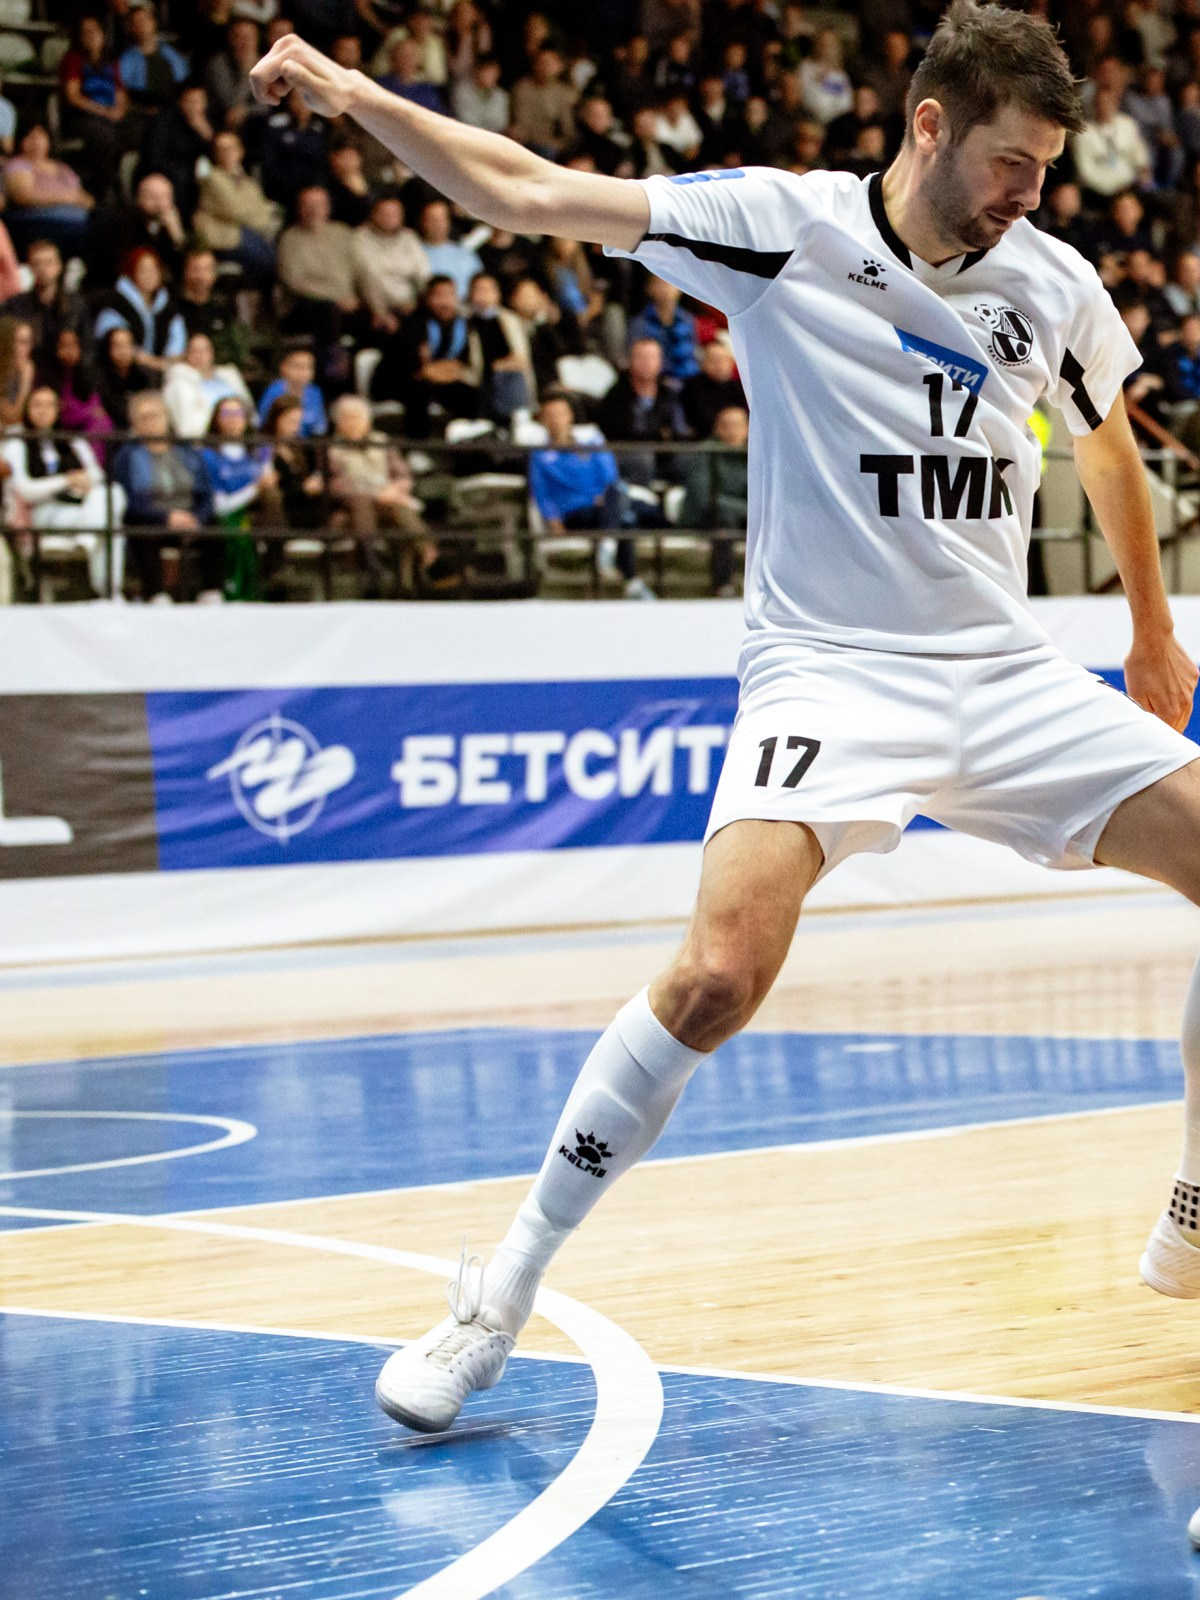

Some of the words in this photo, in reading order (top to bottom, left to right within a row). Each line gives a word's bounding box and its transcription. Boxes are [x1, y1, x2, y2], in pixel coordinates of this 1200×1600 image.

[848, 272, 888, 291] KELME
[922, 372, 979, 437] 17
[754, 735, 822, 789] 17
[559, 1144, 607, 1178] KELME
